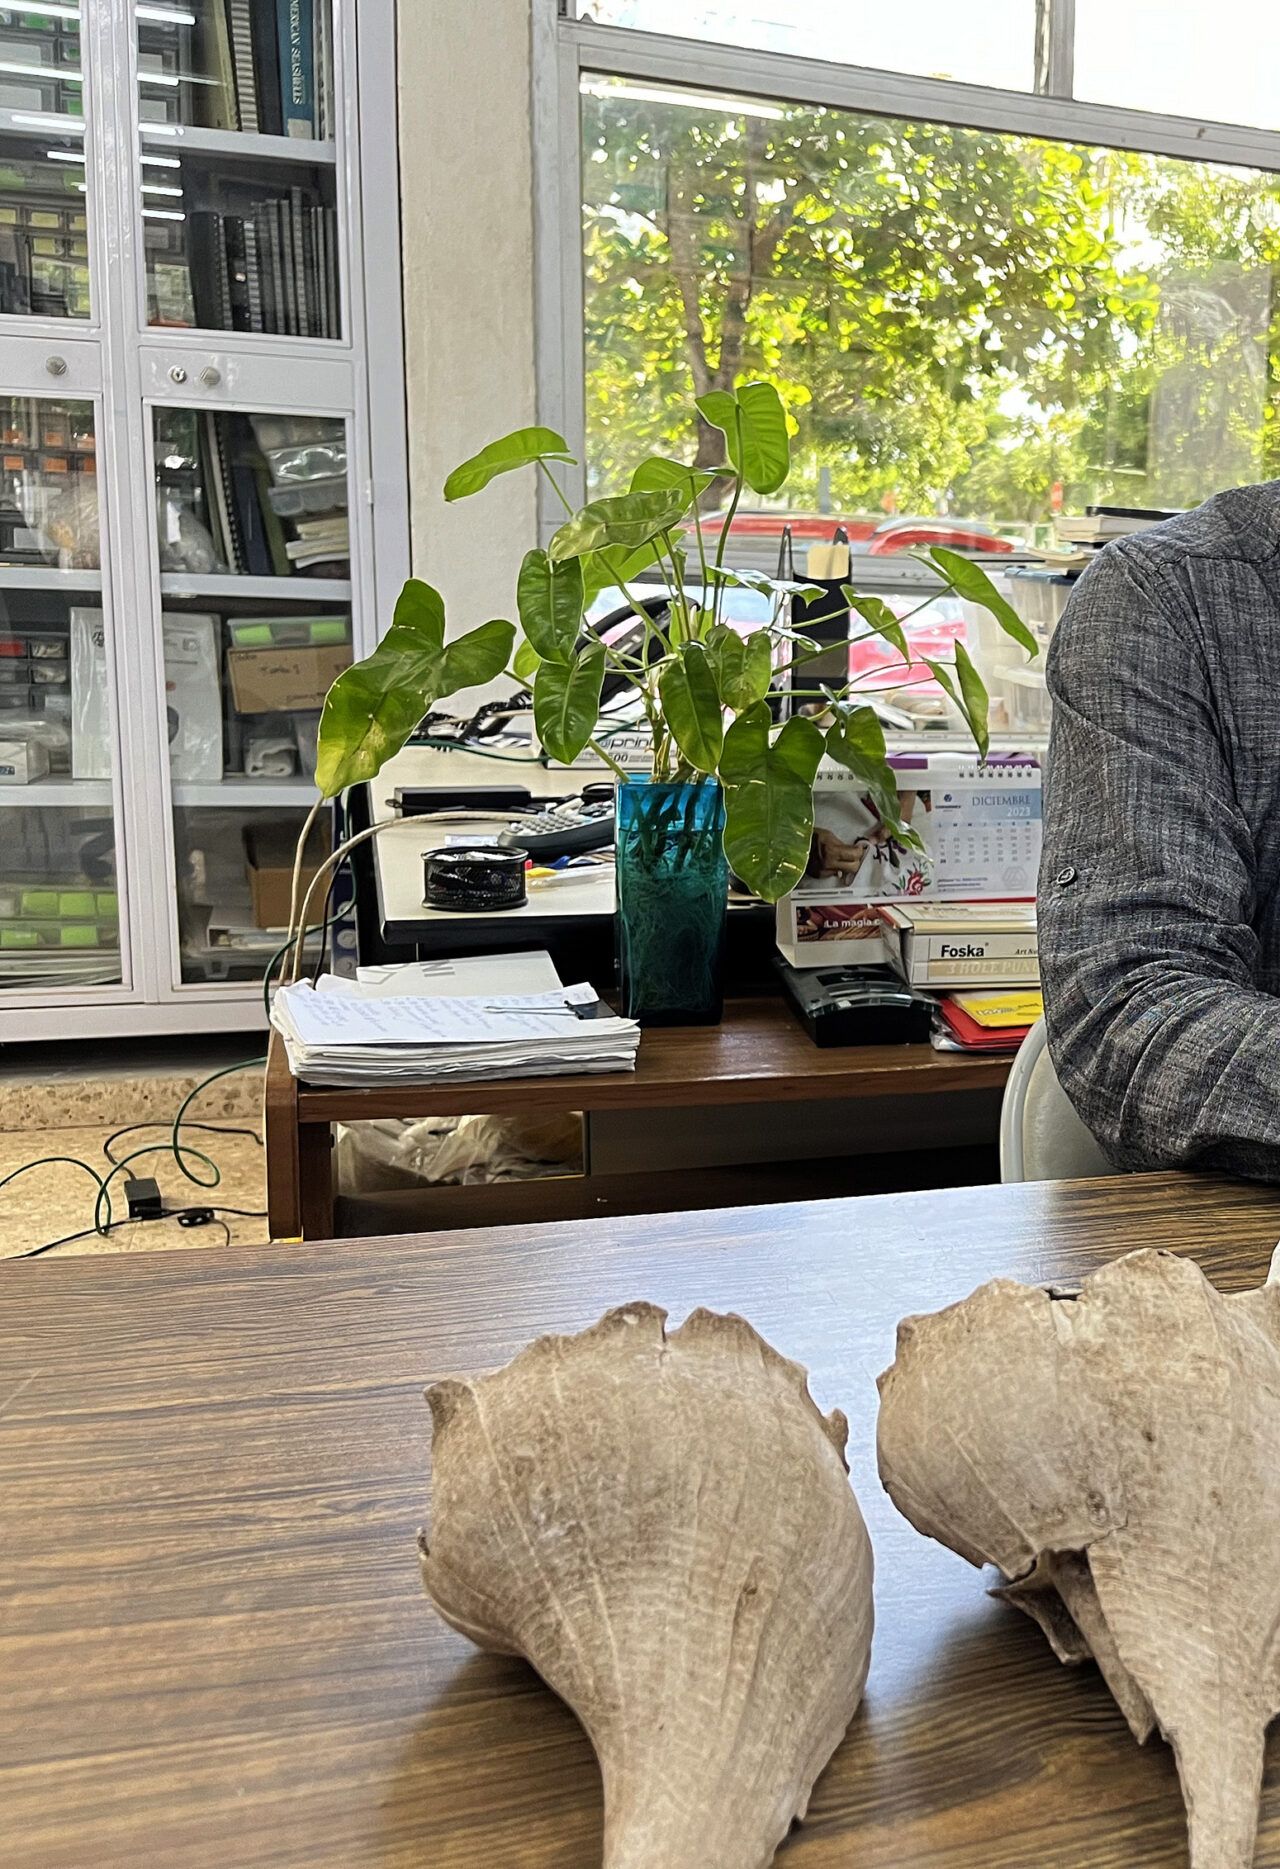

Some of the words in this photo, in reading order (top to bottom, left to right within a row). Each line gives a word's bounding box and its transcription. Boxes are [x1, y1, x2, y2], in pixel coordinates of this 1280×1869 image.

[972, 795, 1031, 807] DICIEMBRE
[1007, 807, 1031, 817] 2023
[941, 944, 984, 958] Foska
